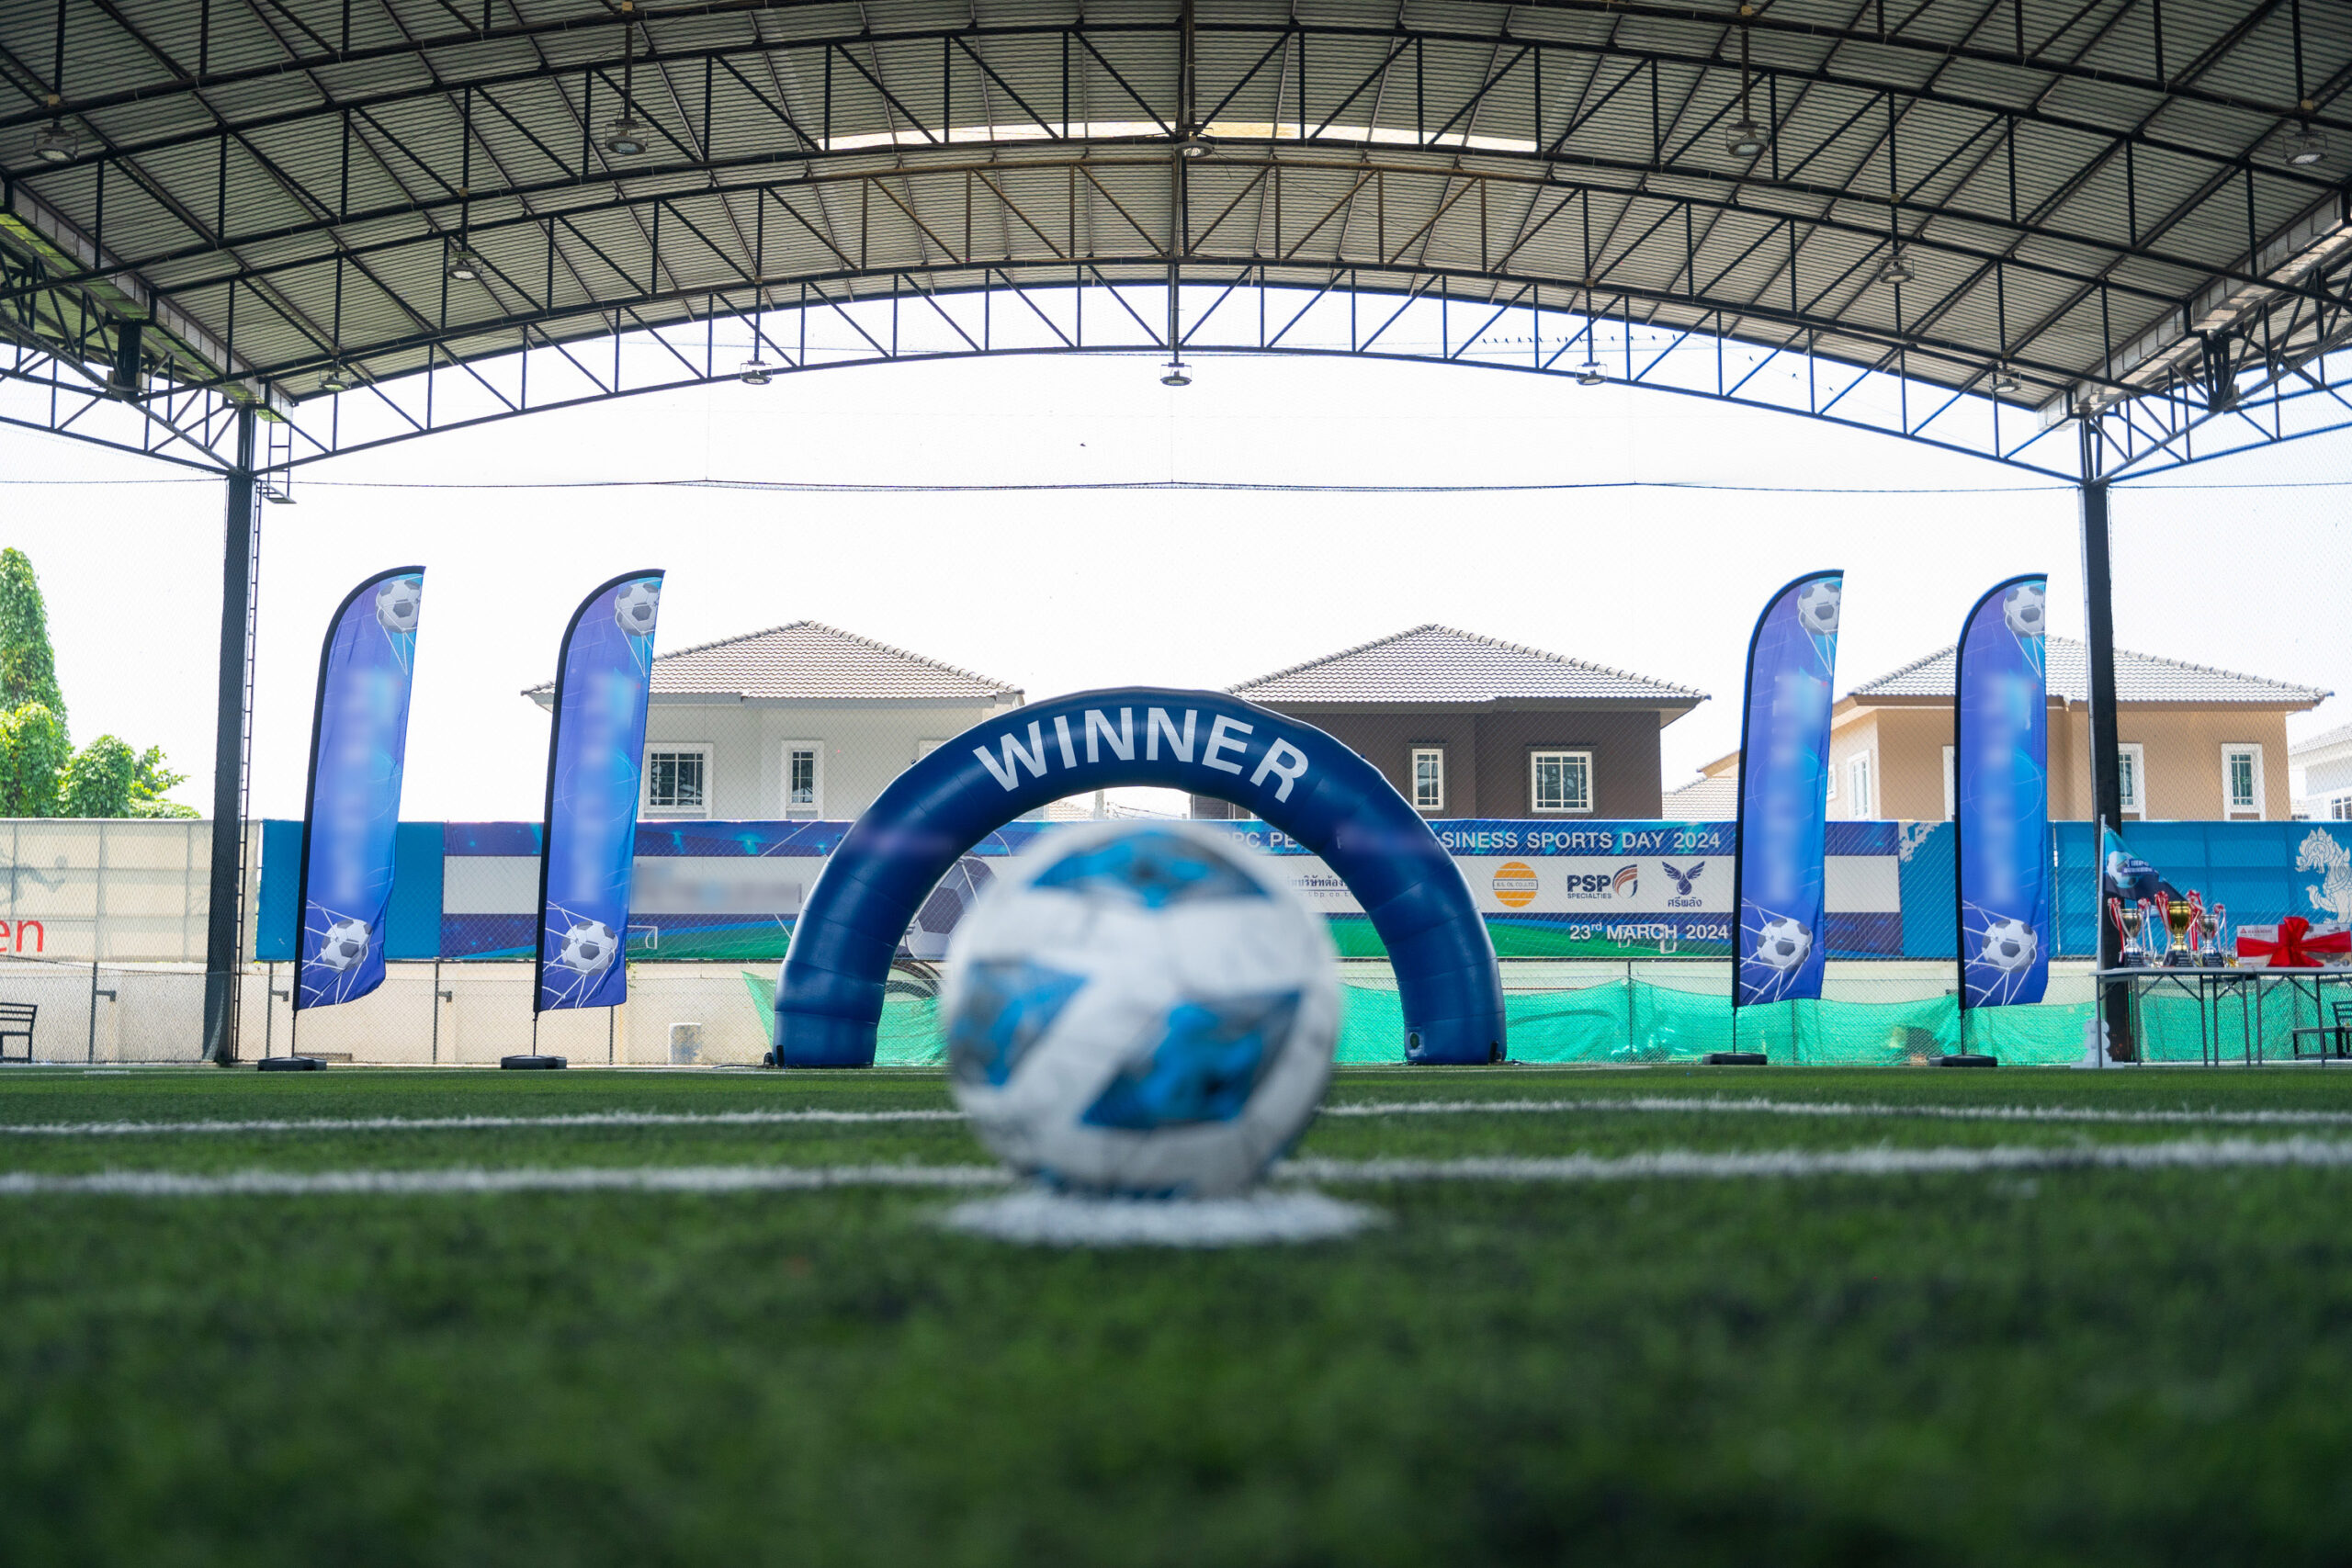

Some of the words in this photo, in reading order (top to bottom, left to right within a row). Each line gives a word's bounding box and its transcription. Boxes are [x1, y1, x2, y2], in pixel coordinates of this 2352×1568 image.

[972, 706, 1309, 804] WINNER
[1438, 831, 1519, 849] SINESS
[1526, 831, 1613, 849] SPORTS
[1622, 831, 1665, 849] DAY
[1673, 831, 1721, 849] 2024
[1566, 874, 1611, 892] PSP
[1667, 896, 1702, 908] ศรีพลัง
[1607, 924, 1678, 940] MARCH
[1686, 924, 1729, 940] 2024
